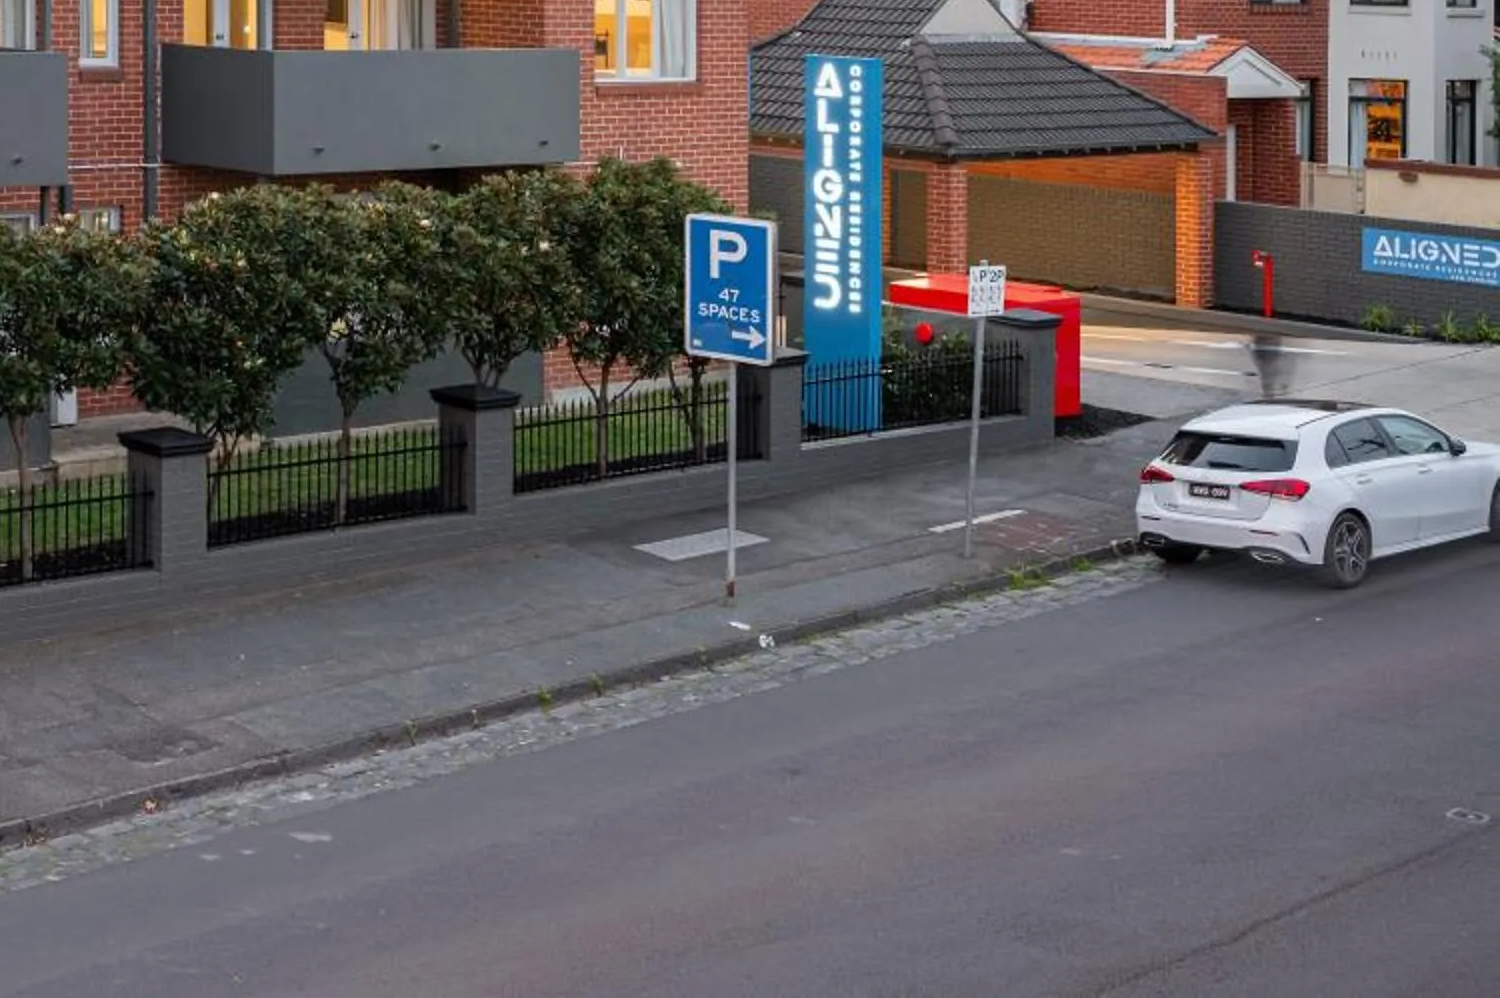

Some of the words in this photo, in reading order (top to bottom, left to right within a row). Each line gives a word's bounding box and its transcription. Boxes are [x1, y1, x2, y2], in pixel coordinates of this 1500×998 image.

[813, 62, 843, 309] ALIGNED
[709, 229, 748, 279] P
[1374, 235, 1500, 268] ALIGNED
[718, 287, 741, 303] 47
[698, 303, 761, 323] SPACES
